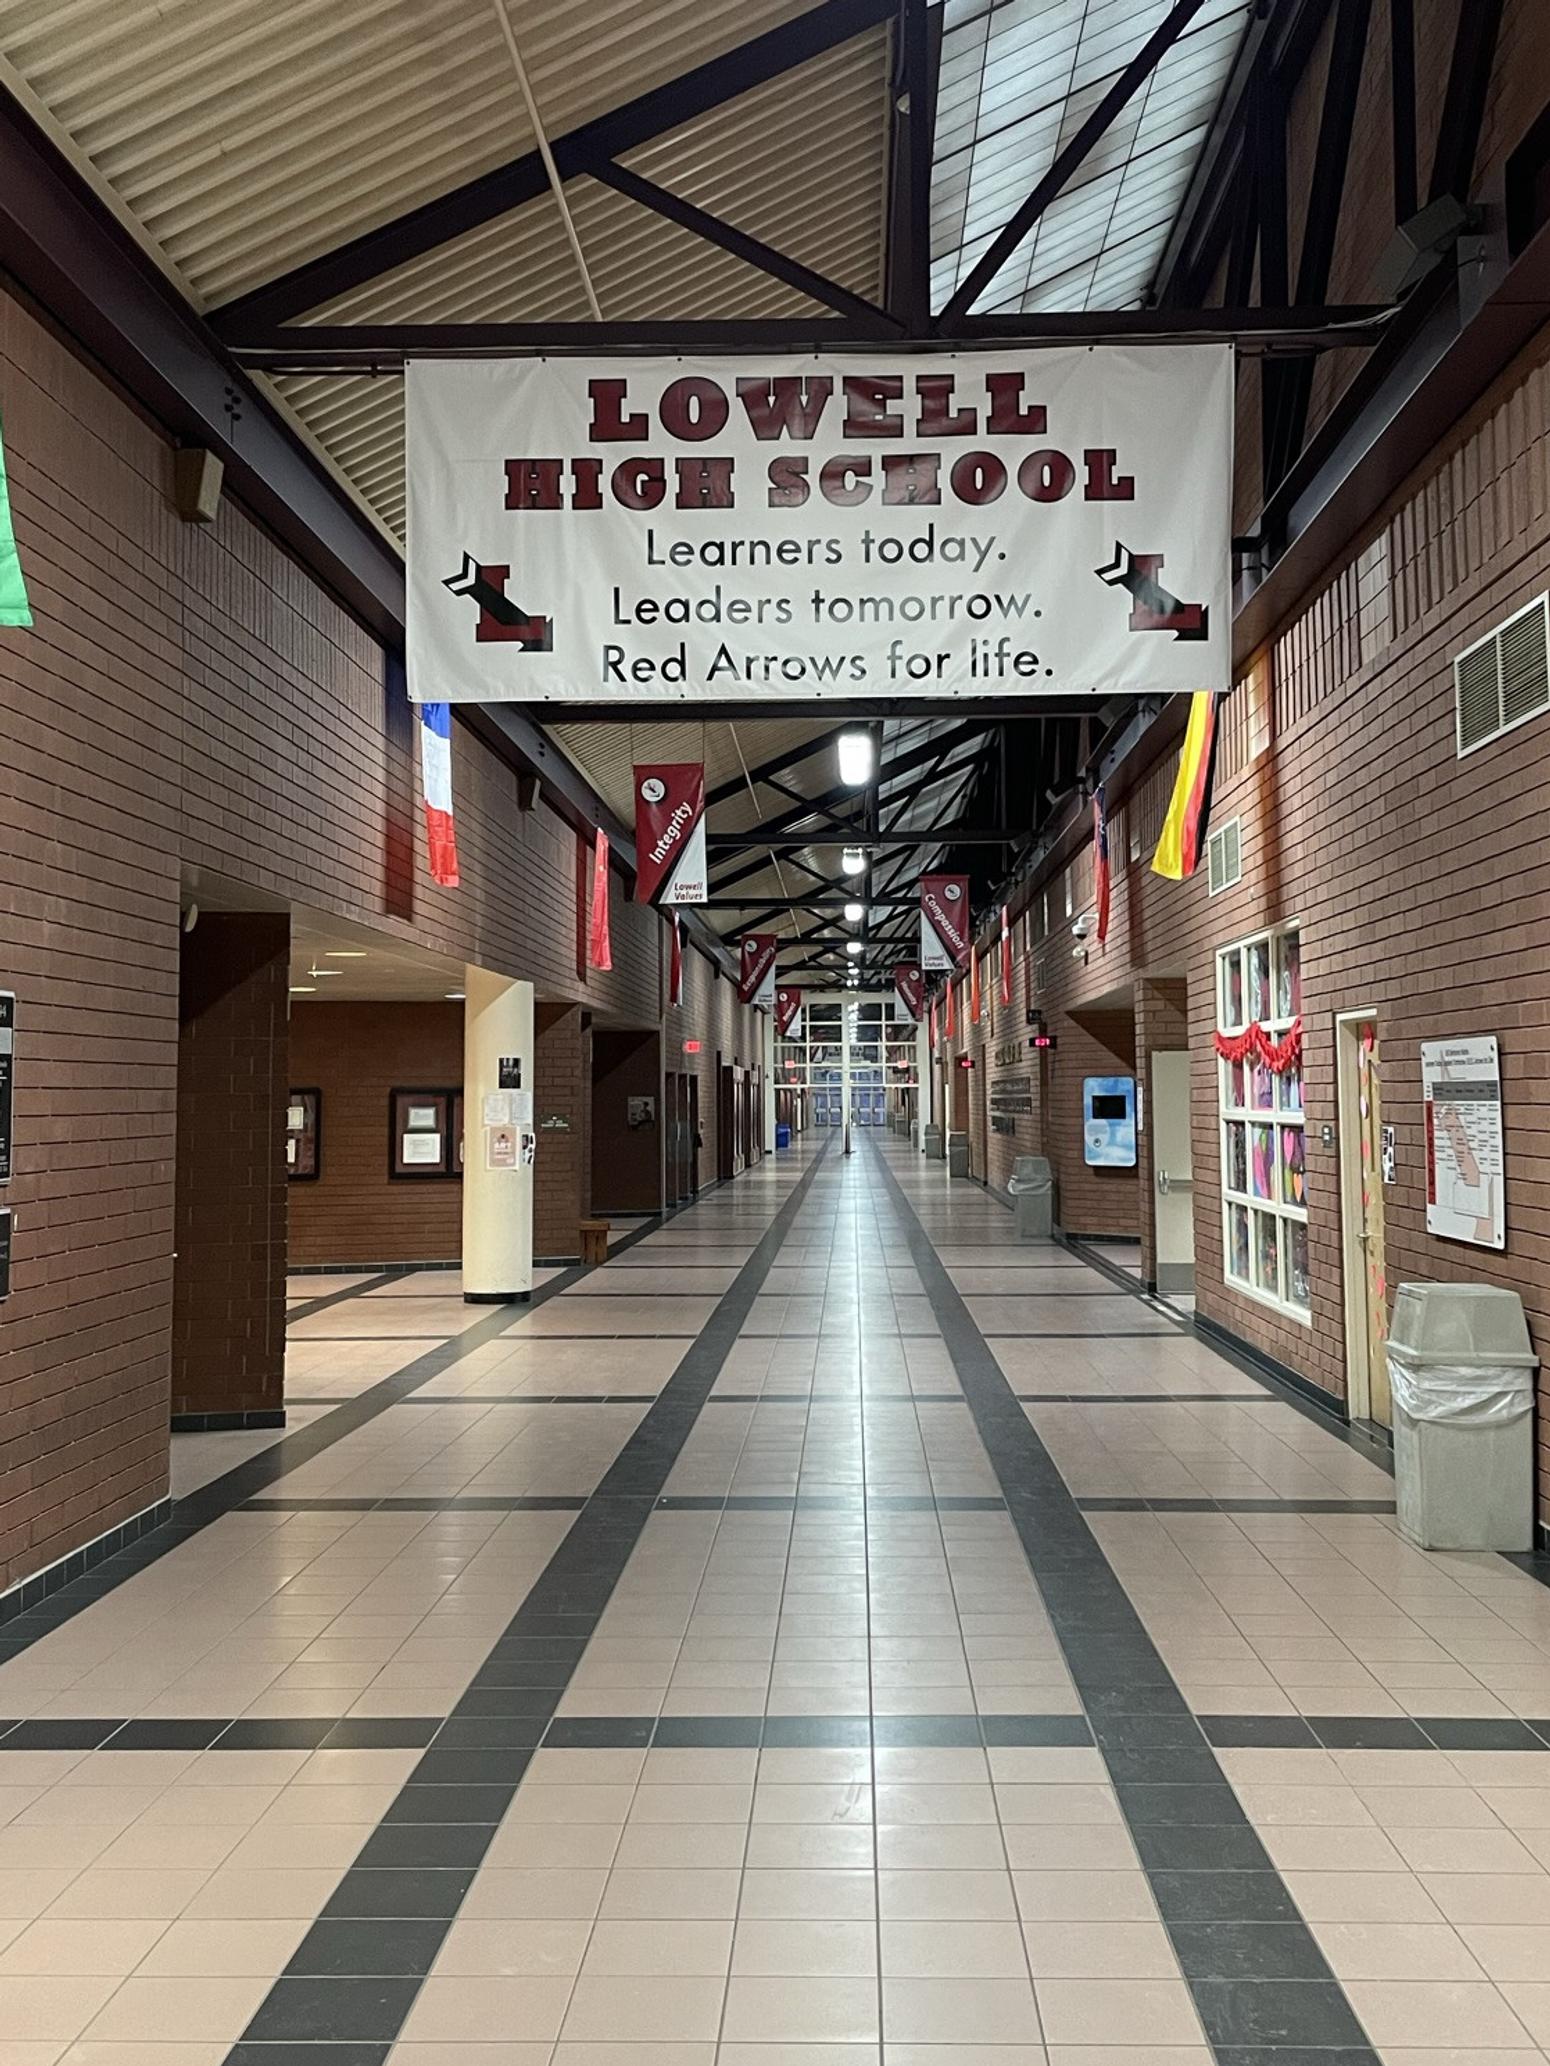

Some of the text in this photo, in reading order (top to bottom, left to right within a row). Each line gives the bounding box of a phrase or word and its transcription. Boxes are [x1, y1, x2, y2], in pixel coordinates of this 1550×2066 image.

[588, 372, 1048, 443] LOWELL
[503, 448, 1136, 511] HIGH SCHOOL
[646, 523, 1008, 573] Learners today.
[612, 586, 1044, 626] Leaders tomorrow.
[602, 637, 1055, 683] Red Arrows for life.
[648, 801, 693, 865] Integrity
[674, 881, 703, 891] Lowell
[674, 891, 703, 901] Values
[924, 893, 965, 950] Compassion
